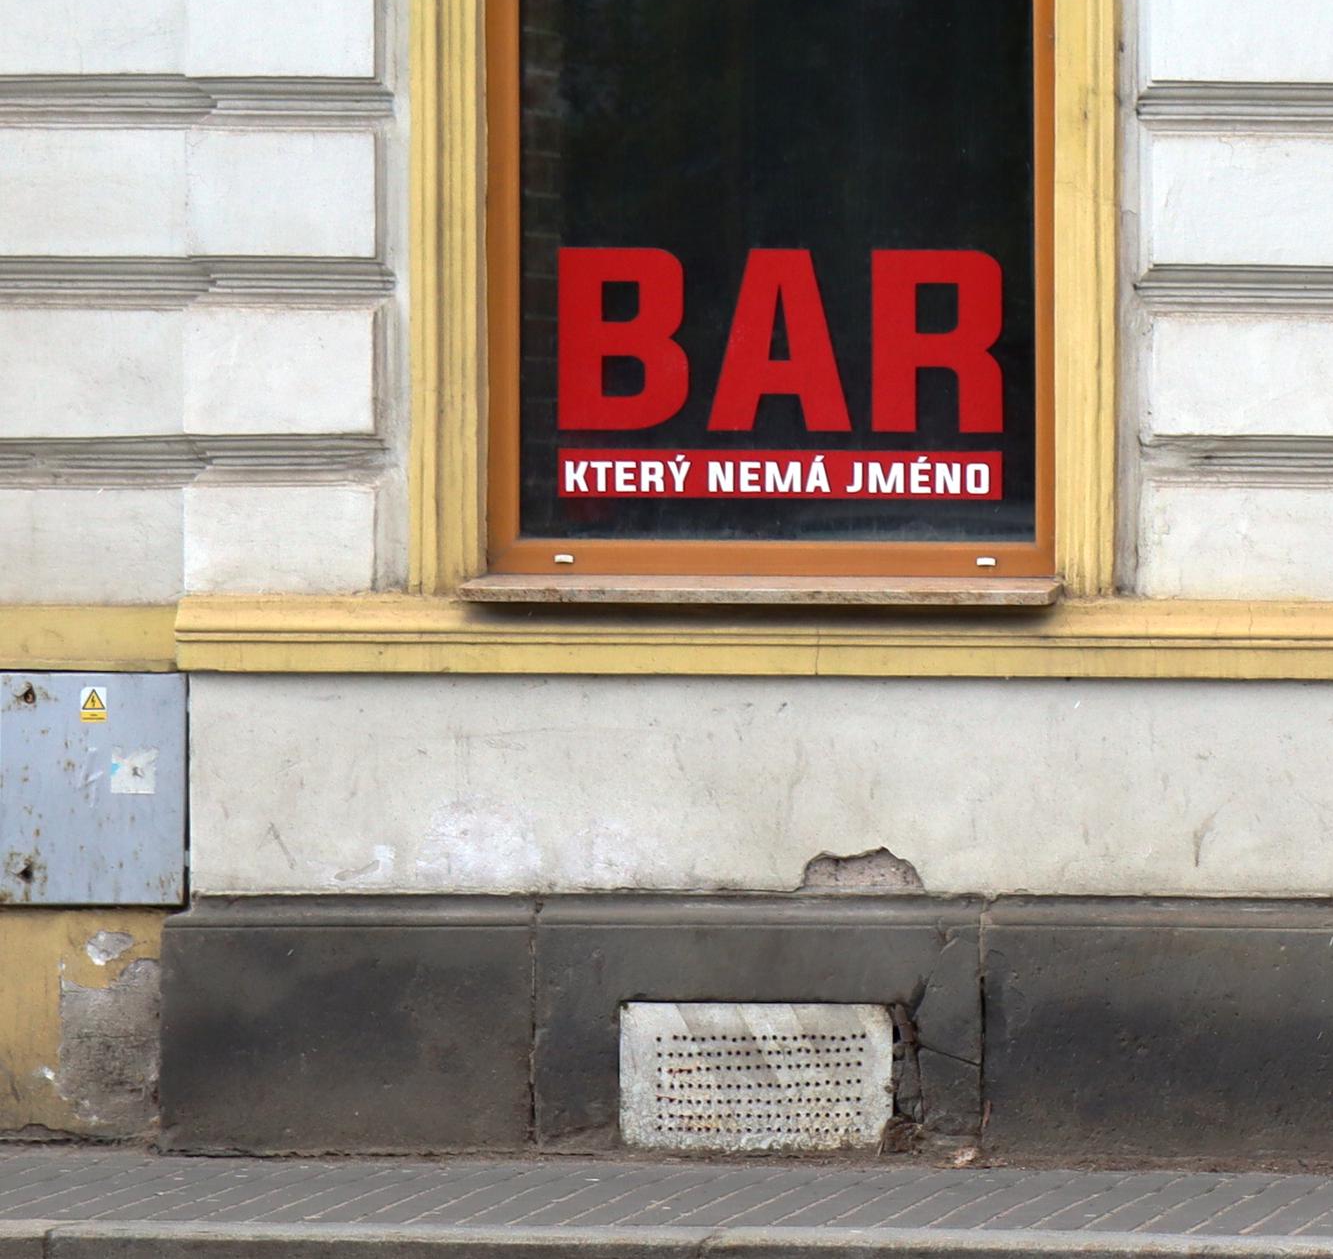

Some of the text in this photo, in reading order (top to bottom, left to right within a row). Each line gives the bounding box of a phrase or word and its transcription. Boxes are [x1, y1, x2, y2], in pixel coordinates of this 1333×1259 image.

[558, 247, 1003, 432] BAR
[564, 455, 990, 494] KTERÝ NEMÁ JMÉNO
